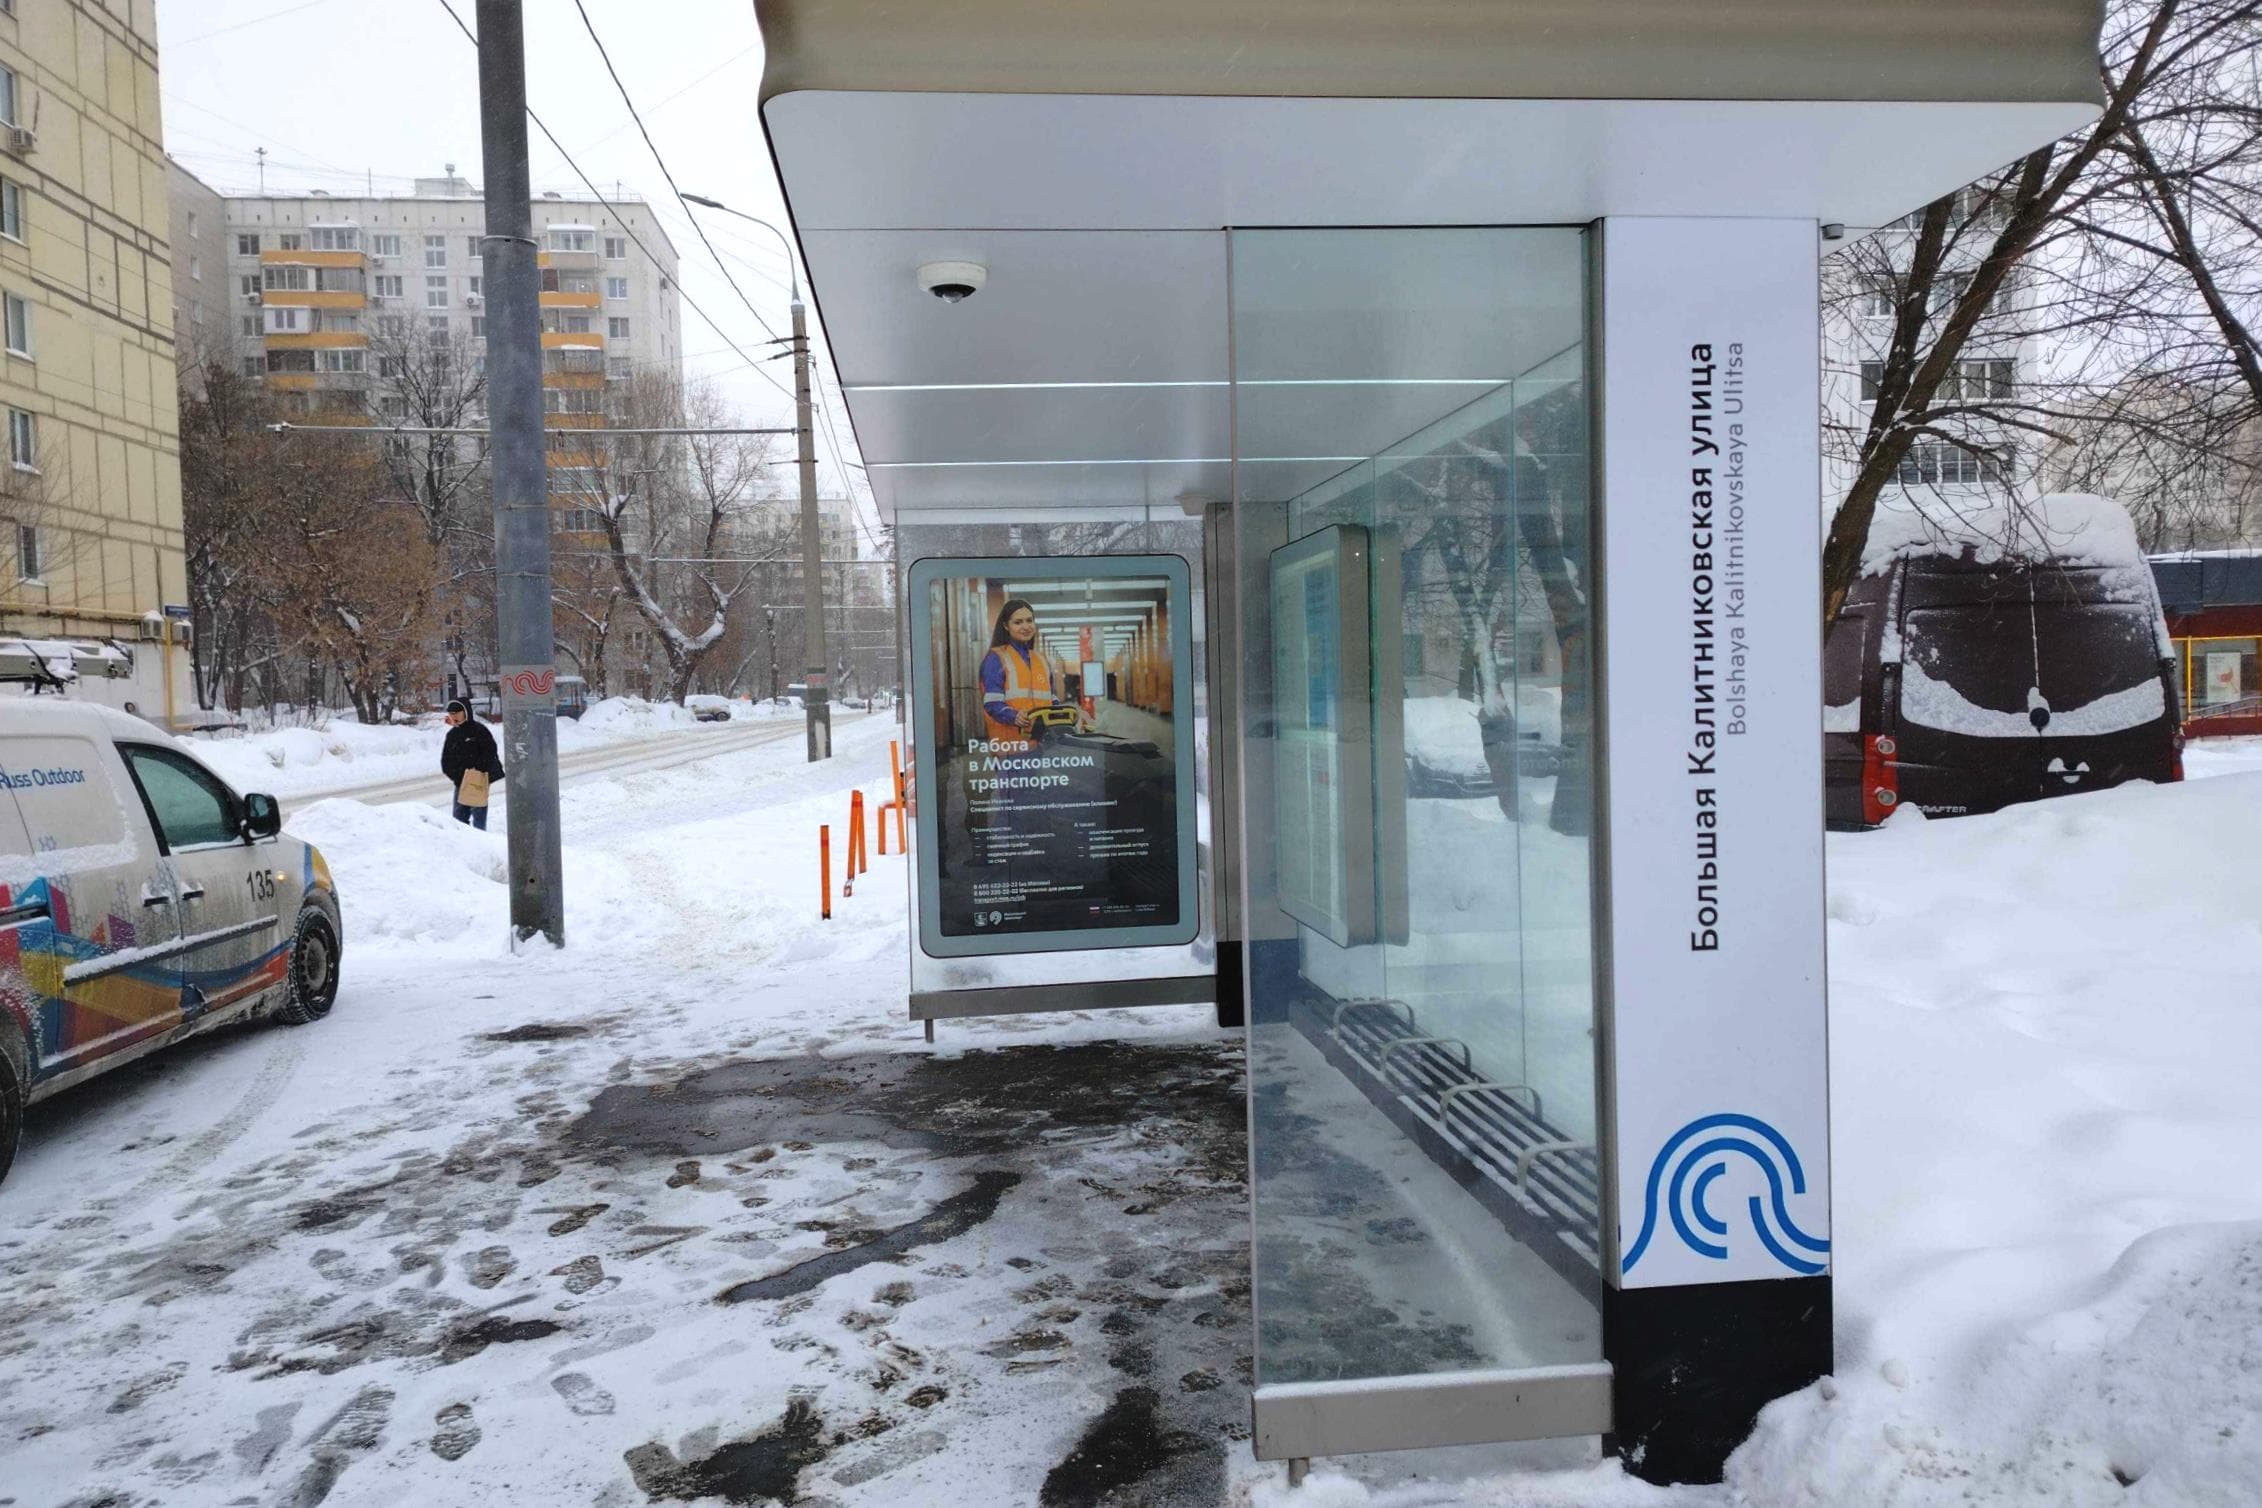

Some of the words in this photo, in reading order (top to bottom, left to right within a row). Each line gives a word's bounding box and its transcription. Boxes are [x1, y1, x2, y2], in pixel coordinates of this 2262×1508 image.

[1691, 344, 1719, 456] улица
[1722, 342, 1744, 415] Ulitsa
[1723, 423, 1748, 618] Kalitnikovskaya
[1688, 468, 1715, 774] Калитниковская
[1726, 626, 1749, 735] Bolshaya
[31, 767, 85, 786] Outdoor
[968, 738, 1029, 753] Работа
[969, 761, 978, 771] в
[982, 755, 1094, 771] Московском
[969, 774, 1069, 793] транспорте
[246, 869, 275, 902] 135
[1691, 788, 1718, 951] Большая
